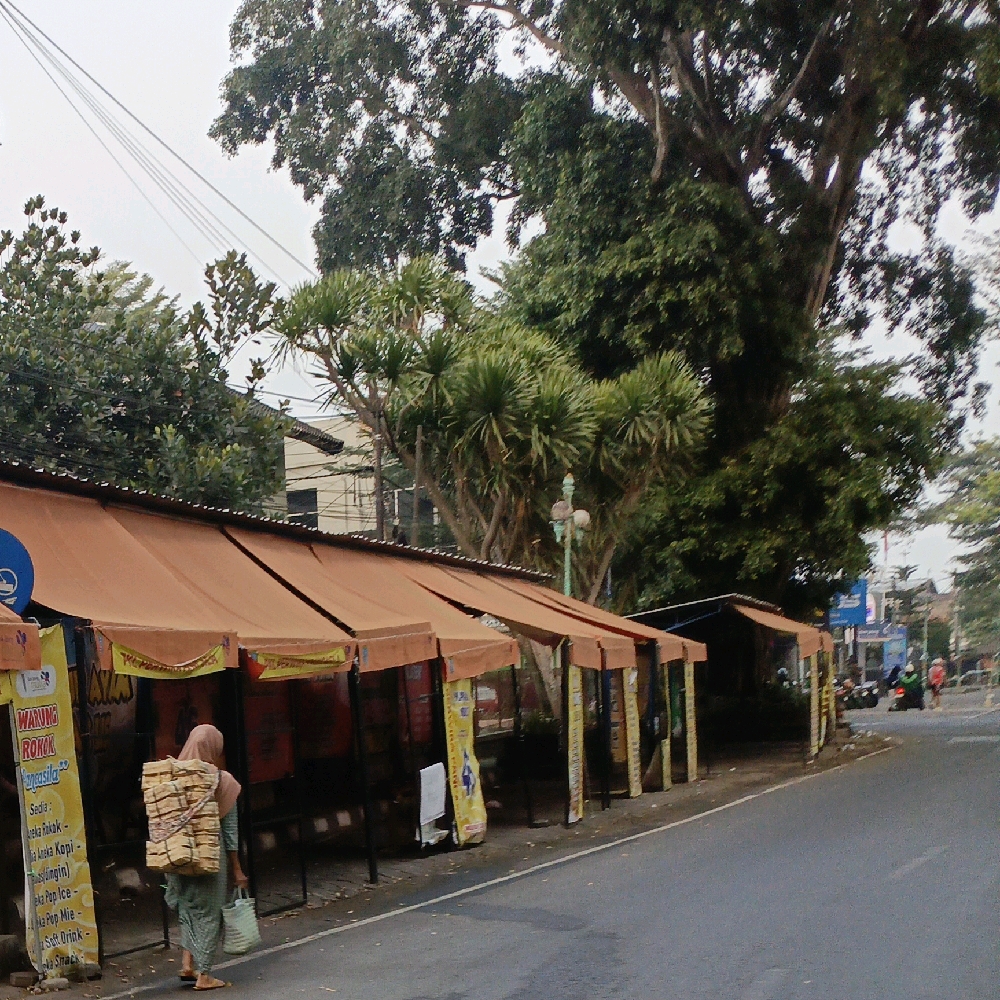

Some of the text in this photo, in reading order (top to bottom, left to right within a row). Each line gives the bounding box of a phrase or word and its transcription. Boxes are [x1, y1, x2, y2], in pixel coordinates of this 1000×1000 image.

[16, 704, 58, 732] WARUNG
[21, 733, 56, 761] ROKOK
[29, 801, 48, 816] Sedia
[55, 840, 74, 858] Kopi
[45, 889, 57, 905] Pop
[58, 886, 72, 900] Ice
[46, 912, 59, 928] Pop
[60, 907, 76, 922] Mie
[60, 928, 83, 945] Drink
